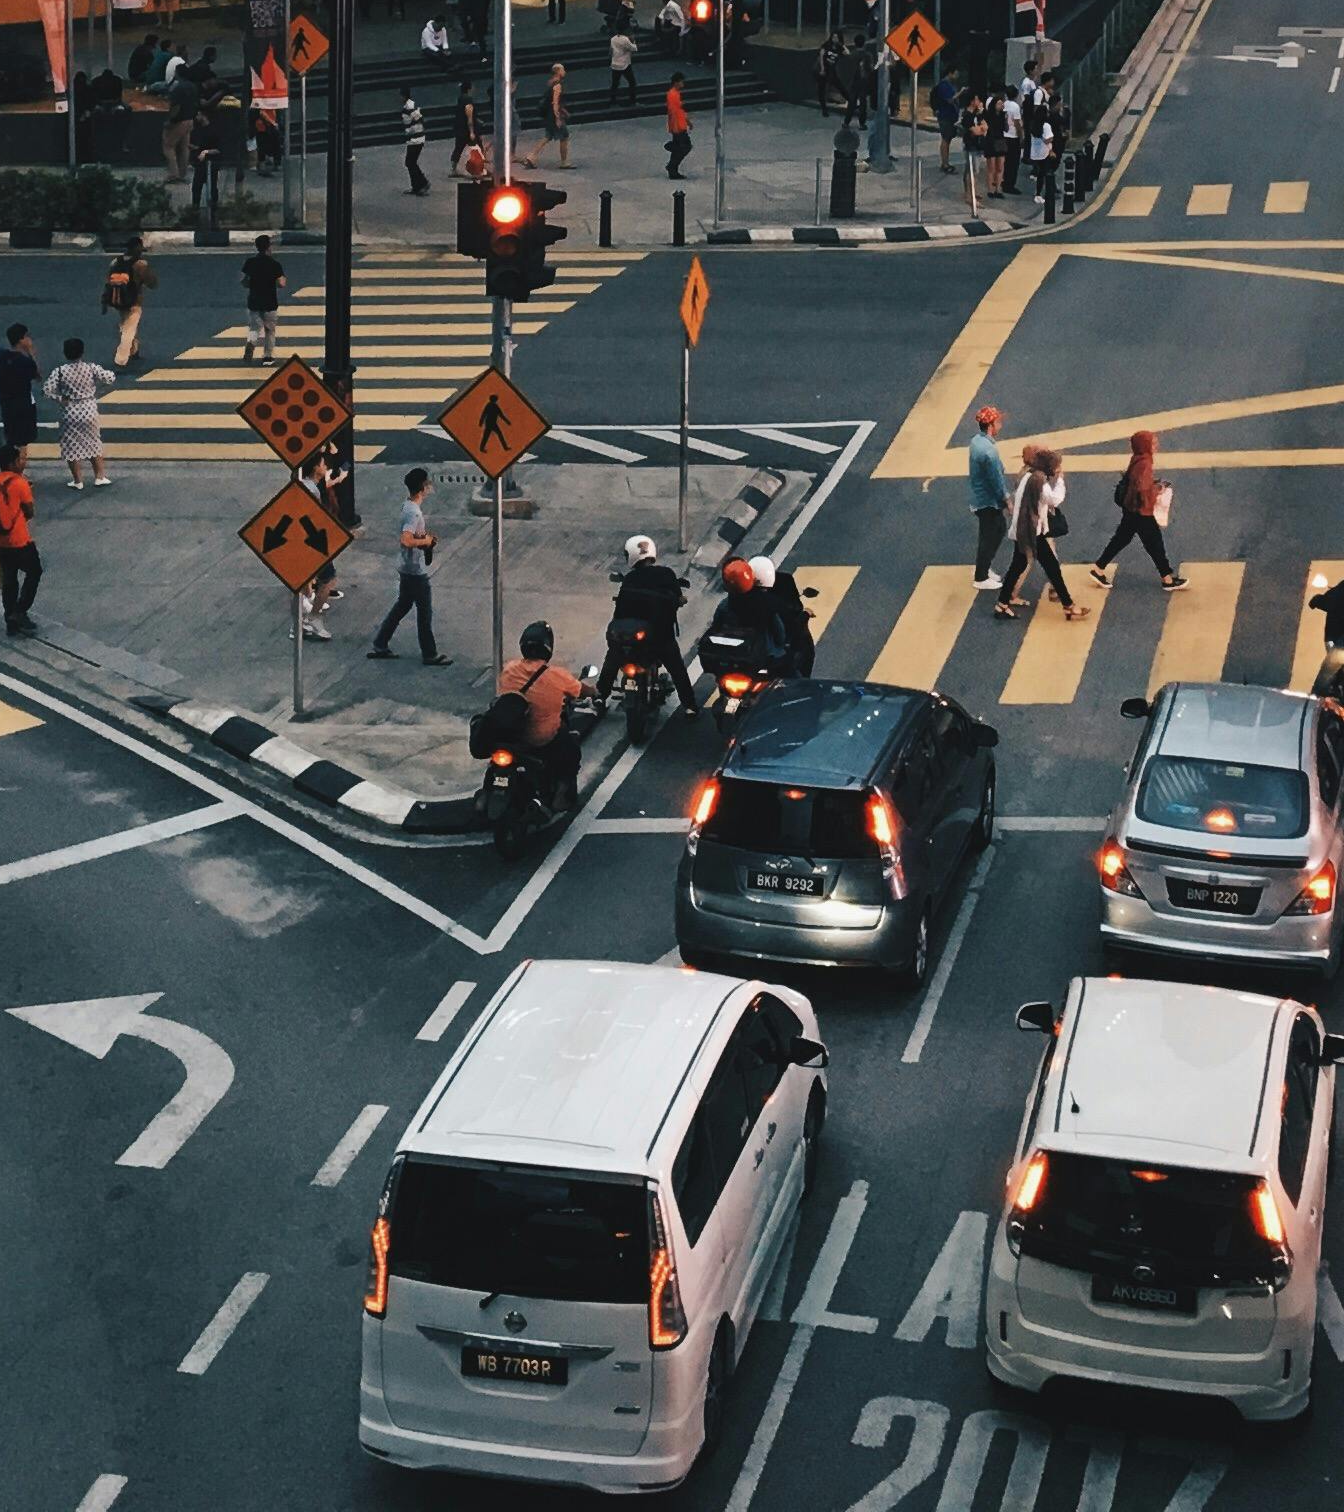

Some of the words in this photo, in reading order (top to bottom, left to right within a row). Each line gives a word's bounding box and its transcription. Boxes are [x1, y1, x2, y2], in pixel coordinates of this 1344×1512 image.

[757, 874, 779, 888] BKR
[785, 877, 814, 892] 9292
[1187, 887, 1209, 902] BNP
[1212, 891, 1239, 905] 1220
[477, 1354, 497, 1372] WB
